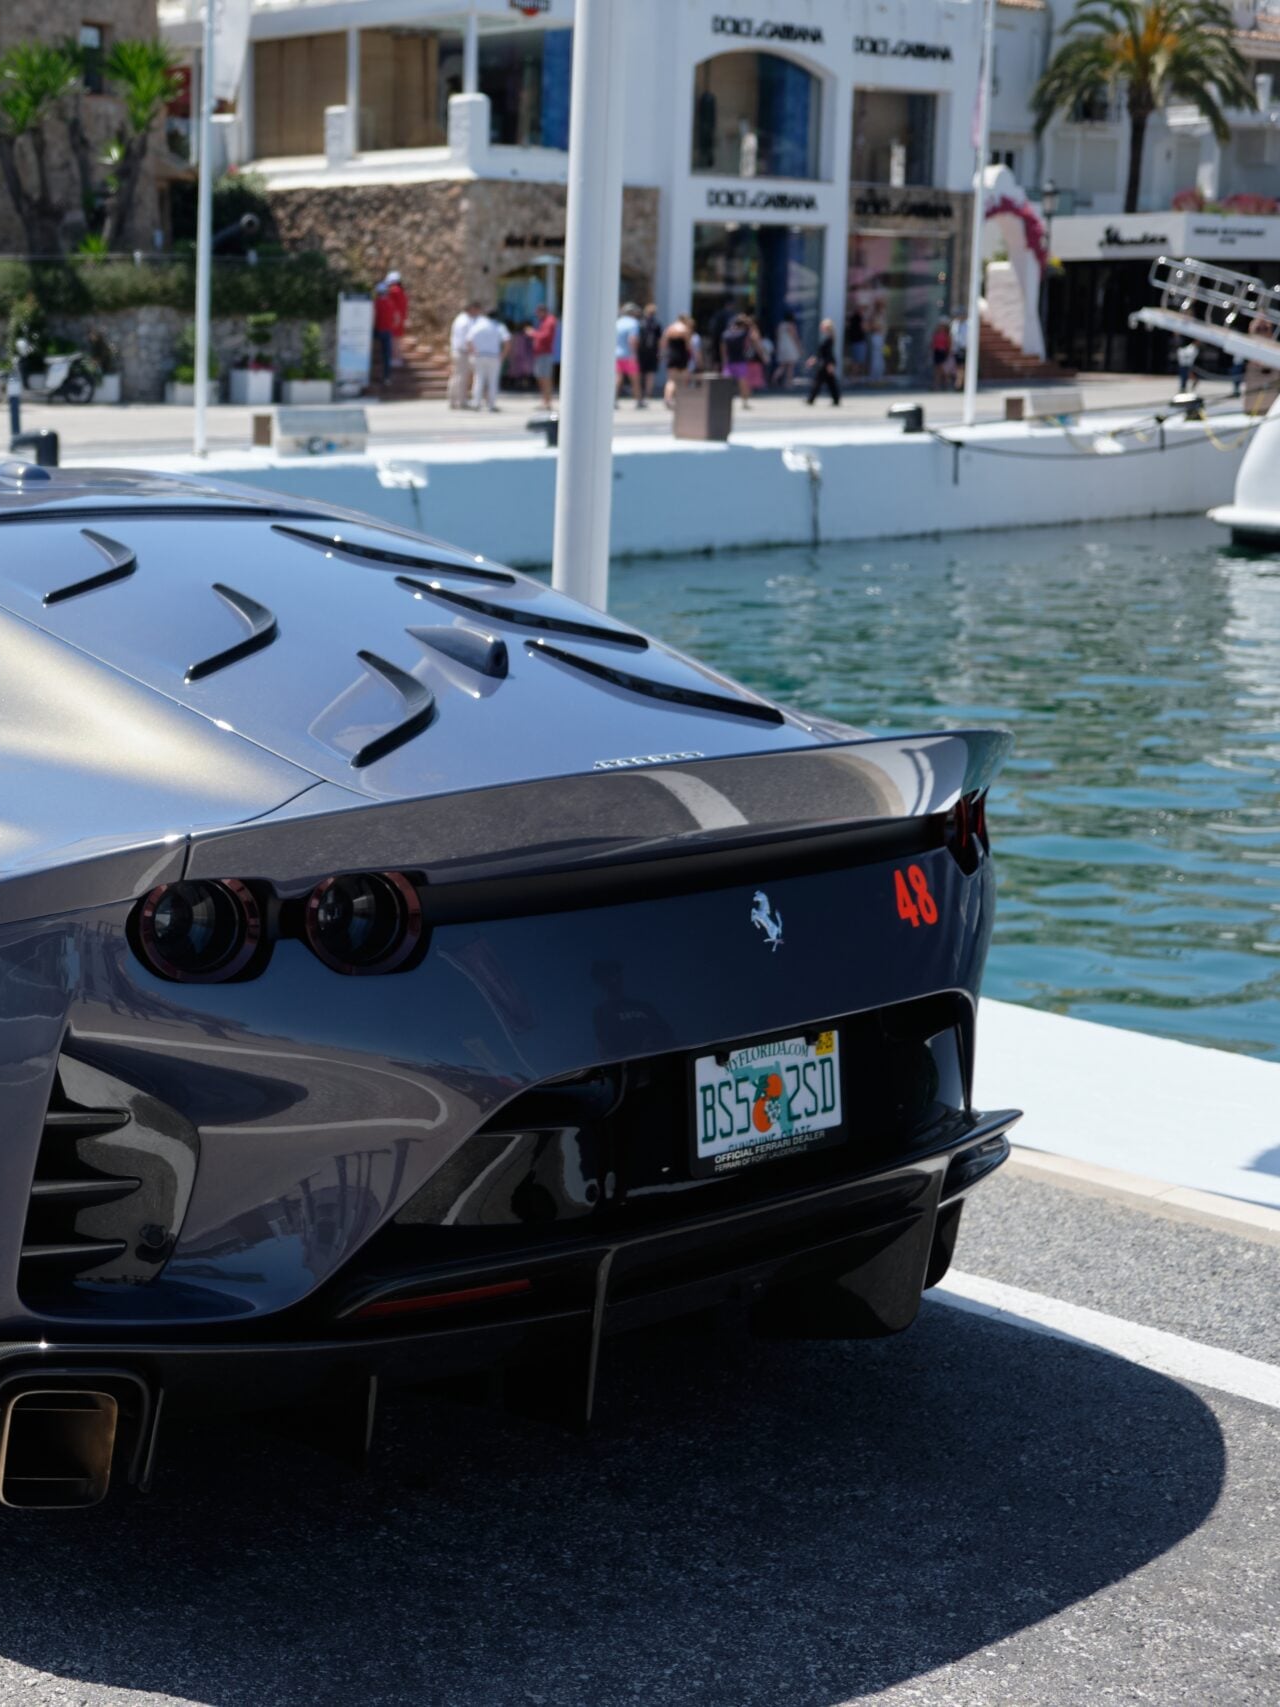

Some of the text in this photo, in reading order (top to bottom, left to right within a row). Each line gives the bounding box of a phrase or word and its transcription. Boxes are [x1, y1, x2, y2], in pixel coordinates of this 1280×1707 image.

[894, 864, 938, 927] 48
[724, 1041, 809, 1073] MYFLORIDA.COM
[714, 1130, 825, 1164] OFFICIAL FERRARI DEALER
[714, 1160, 742, 1172] FERRARI
